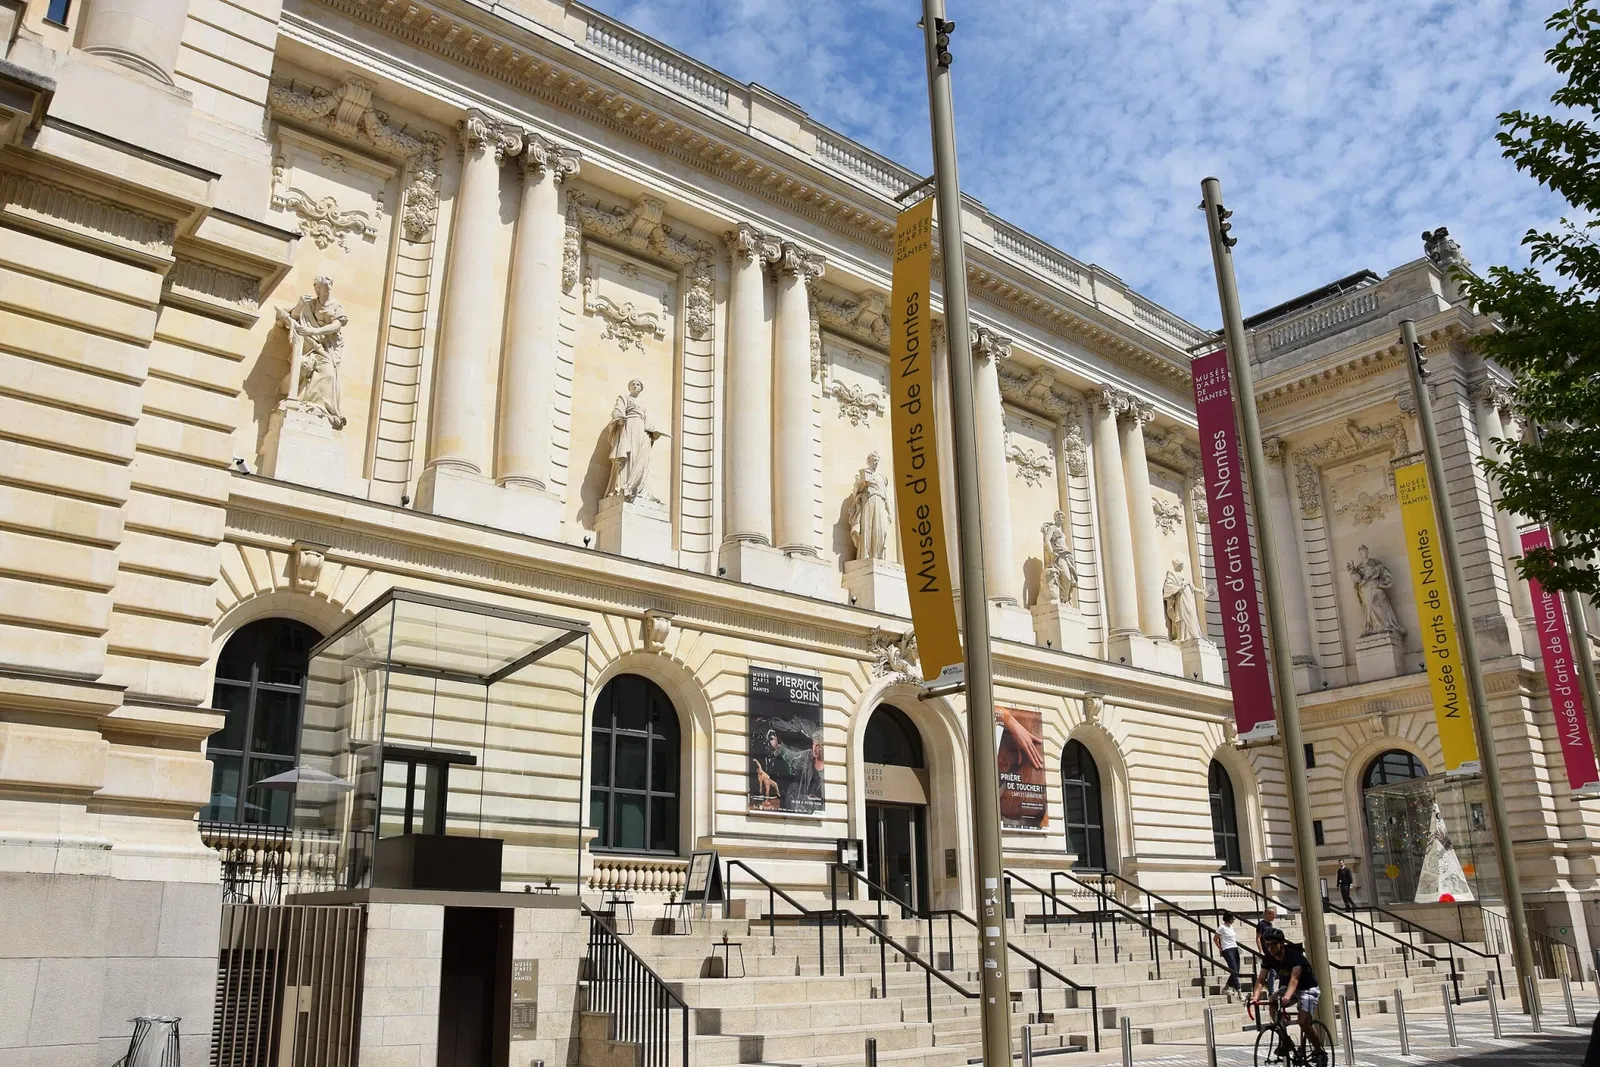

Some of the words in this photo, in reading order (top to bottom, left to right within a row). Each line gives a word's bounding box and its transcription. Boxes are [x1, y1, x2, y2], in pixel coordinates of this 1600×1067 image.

[897, 225, 929, 248] D'ARTS
[898, 217, 929, 239] MUSÉE
[896, 241, 928, 263] NANTES
[897, 245, 906, 256] DE
[900, 291, 920, 379] Nantes
[1195, 367, 1226, 383] MUSÉE
[1196, 375, 1226, 390] D'ARTS
[900, 383, 921, 415] de
[1197, 388, 1207, 397] DE
[1198, 388, 1228, 404] NANTES
[905, 422, 927, 495] d'arts
[1213, 429, 1233, 500] Nantes
[1402, 494, 1428, 506] NANTES
[1216, 504, 1237, 530] de
[912, 504, 939, 593] Musée
[1419, 528, 1434, 585] Nantes
[1224, 536, 1245, 592] d'arts
[1423, 588, 1439, 609] de
[1541, 589, 1559, 633] Nante
[1231, 598, 1256, 667] Musée
[1431, 614, 1449, 659] d'arts
[1547, 636, 1561, 655] de
[775, 675, 820, 692] PIERRICK
[1553, 657, 1571, 697] d'arts
[790, 688, 820, 703] SORIN
[1437, 664, 1461, 719] Musée
[1561, 699, 1583, 747] Musée
[1000, 773, 1022, 782] PRIÈRE
[1006, 782, 1015, 790] DE
[1016, 783, 1041, 792] TOUCHER
